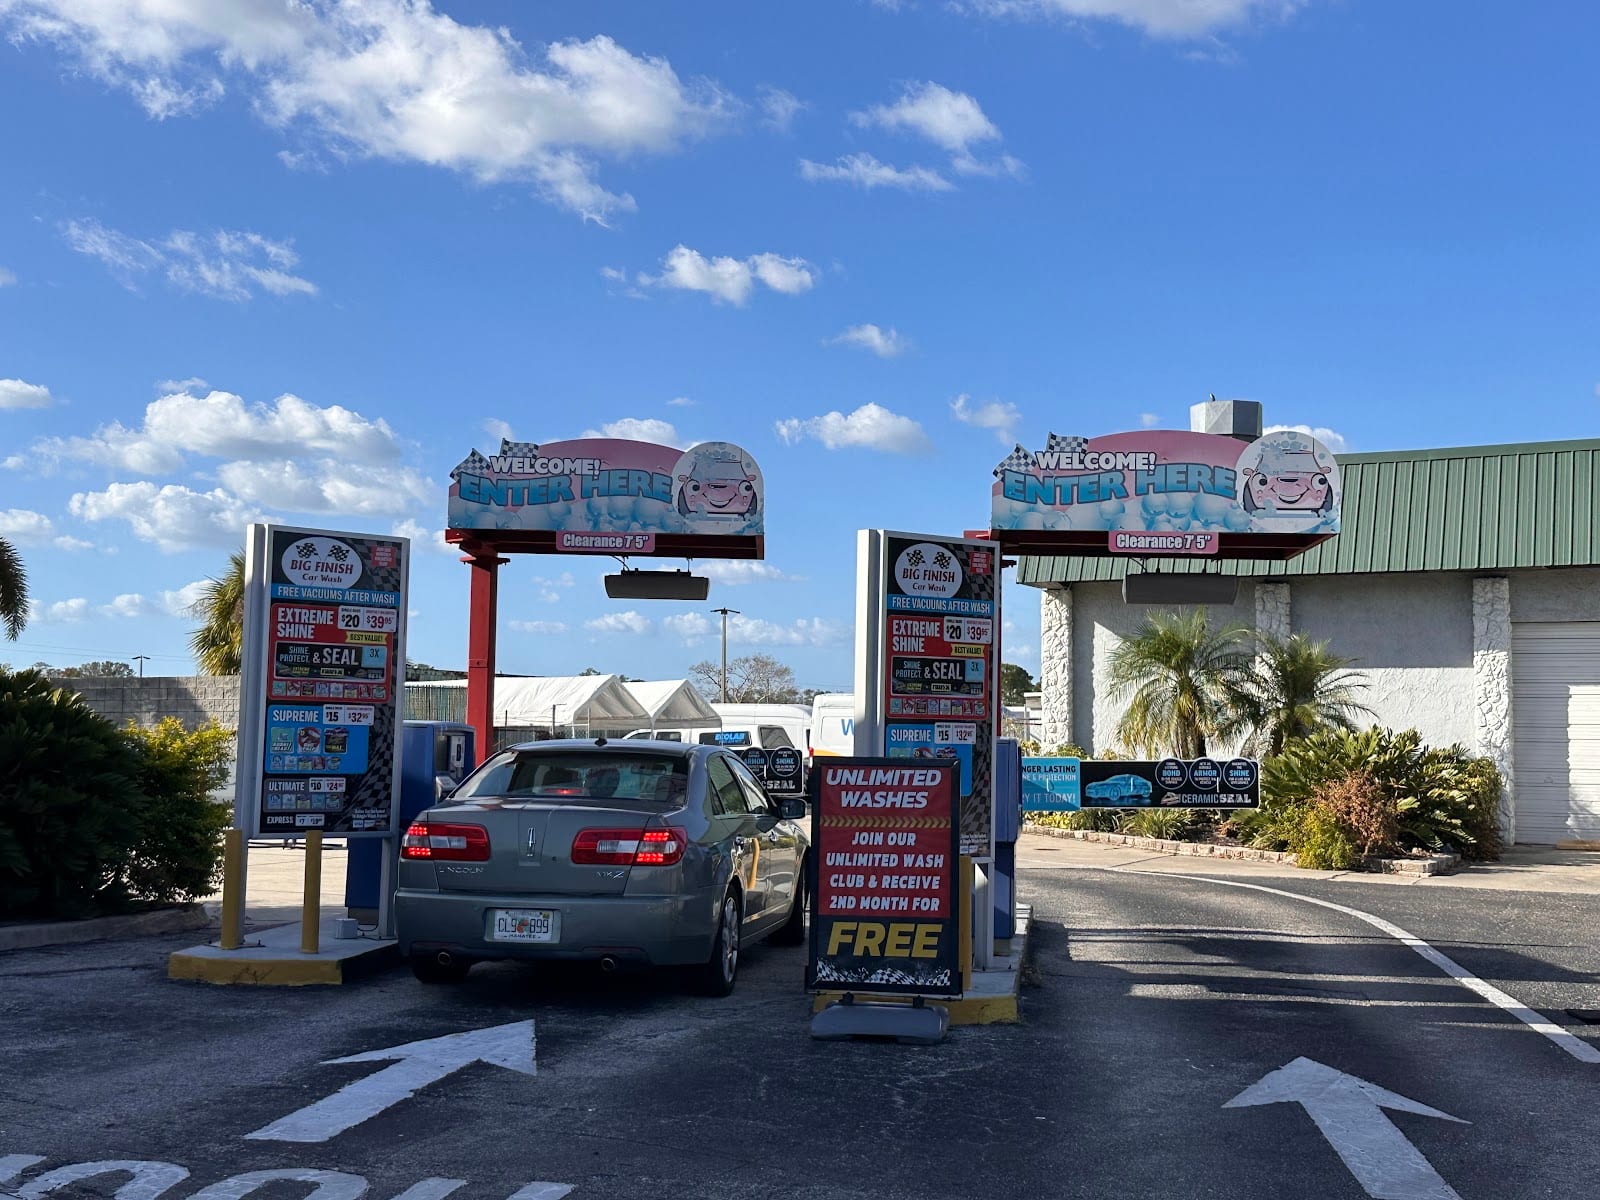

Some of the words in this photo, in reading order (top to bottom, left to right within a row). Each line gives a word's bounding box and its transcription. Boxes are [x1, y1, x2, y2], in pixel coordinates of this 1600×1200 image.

[490, 456, 601, 476] WELCOME!
[1035, 451, 1156, 471] WELCOME!
[458, 471, 575, 506] ENTER
[581, 468, 673, 504] HERE
[1003, 468, 1128, 506] ENTER
[1135, 462, 1237, 500] HERE
[563, 534, 623, 548] Clearance
[1116, 534, 1183, 549] Clearance
[290, 560, 312, 571] BIG
[314, 562, 354, 574] FINISH
[302, 573, 318, 582] Car
[320, 575, 342, 583] Wash
[902, 569, 920, 580] BIG
[923, 570, 955, 582] FINISH
[912, 582, 926, 591] Car
[928, 583, 946, 592] Wash
[278, 586, 299, 597] FREE
[301, 588, 342, 600] VACUUMS
[344, 591, 370, 602] AFTER
[371, 593, 395, 604] WASH
[892, 598, 910, 609] FREE
[912, 599, 947, 611] VACUUMS
[948, 602, 969, 612] AFTER
[971, 603, 991, 614] WASH
[278, 607, 333, 625] EXTREME
[341, 613, 360, 628] $20
[277, 623, 315, 639] SHINE
[892, 619, 941, 637] EXTREME
[946, 626, 962, 640] $20
[892, 636, 925, 653] SHINE
[313, 652, 321, 664] &
[323, 648, 359, 665] SEAL
[369, 649, 380, 658] 3X
[924, 667, 931, 679] &
[932, 662, 963, 680] SEAL
[272, 710, 319, 722] SUPREME
[890, 729, 931, 742] SUPREME
[1044, 765, 1076, 773] LASTING
[826, 769, 942, 786] UNLIMITED
[268, 782, 305, 791] ULTIMATE
[841, 791, 929, 808] WASHES
[1033, 793, 1041, 804] IT
[1044, 793, 1076, 804] TODAY!
[266, 816, 294, 824] EXPRESS
[851, 832, 883, 845] JOIN
[887, 832, 917, 846] OUR
[826, 853, 899, 867] UNLIMITED
[903, 854, 944, 868] WASH
[830, 875, 864, 888] CLUB
[868, 875, 877, 888] &
[881, 876, 940, 889] RECEIVE
[829, 896, 855, 909] 2ND
[859, 897, 908, 910] MONTH
[912, 898, 940, 911] FOR
[827, 921, 943, 958] FREE
